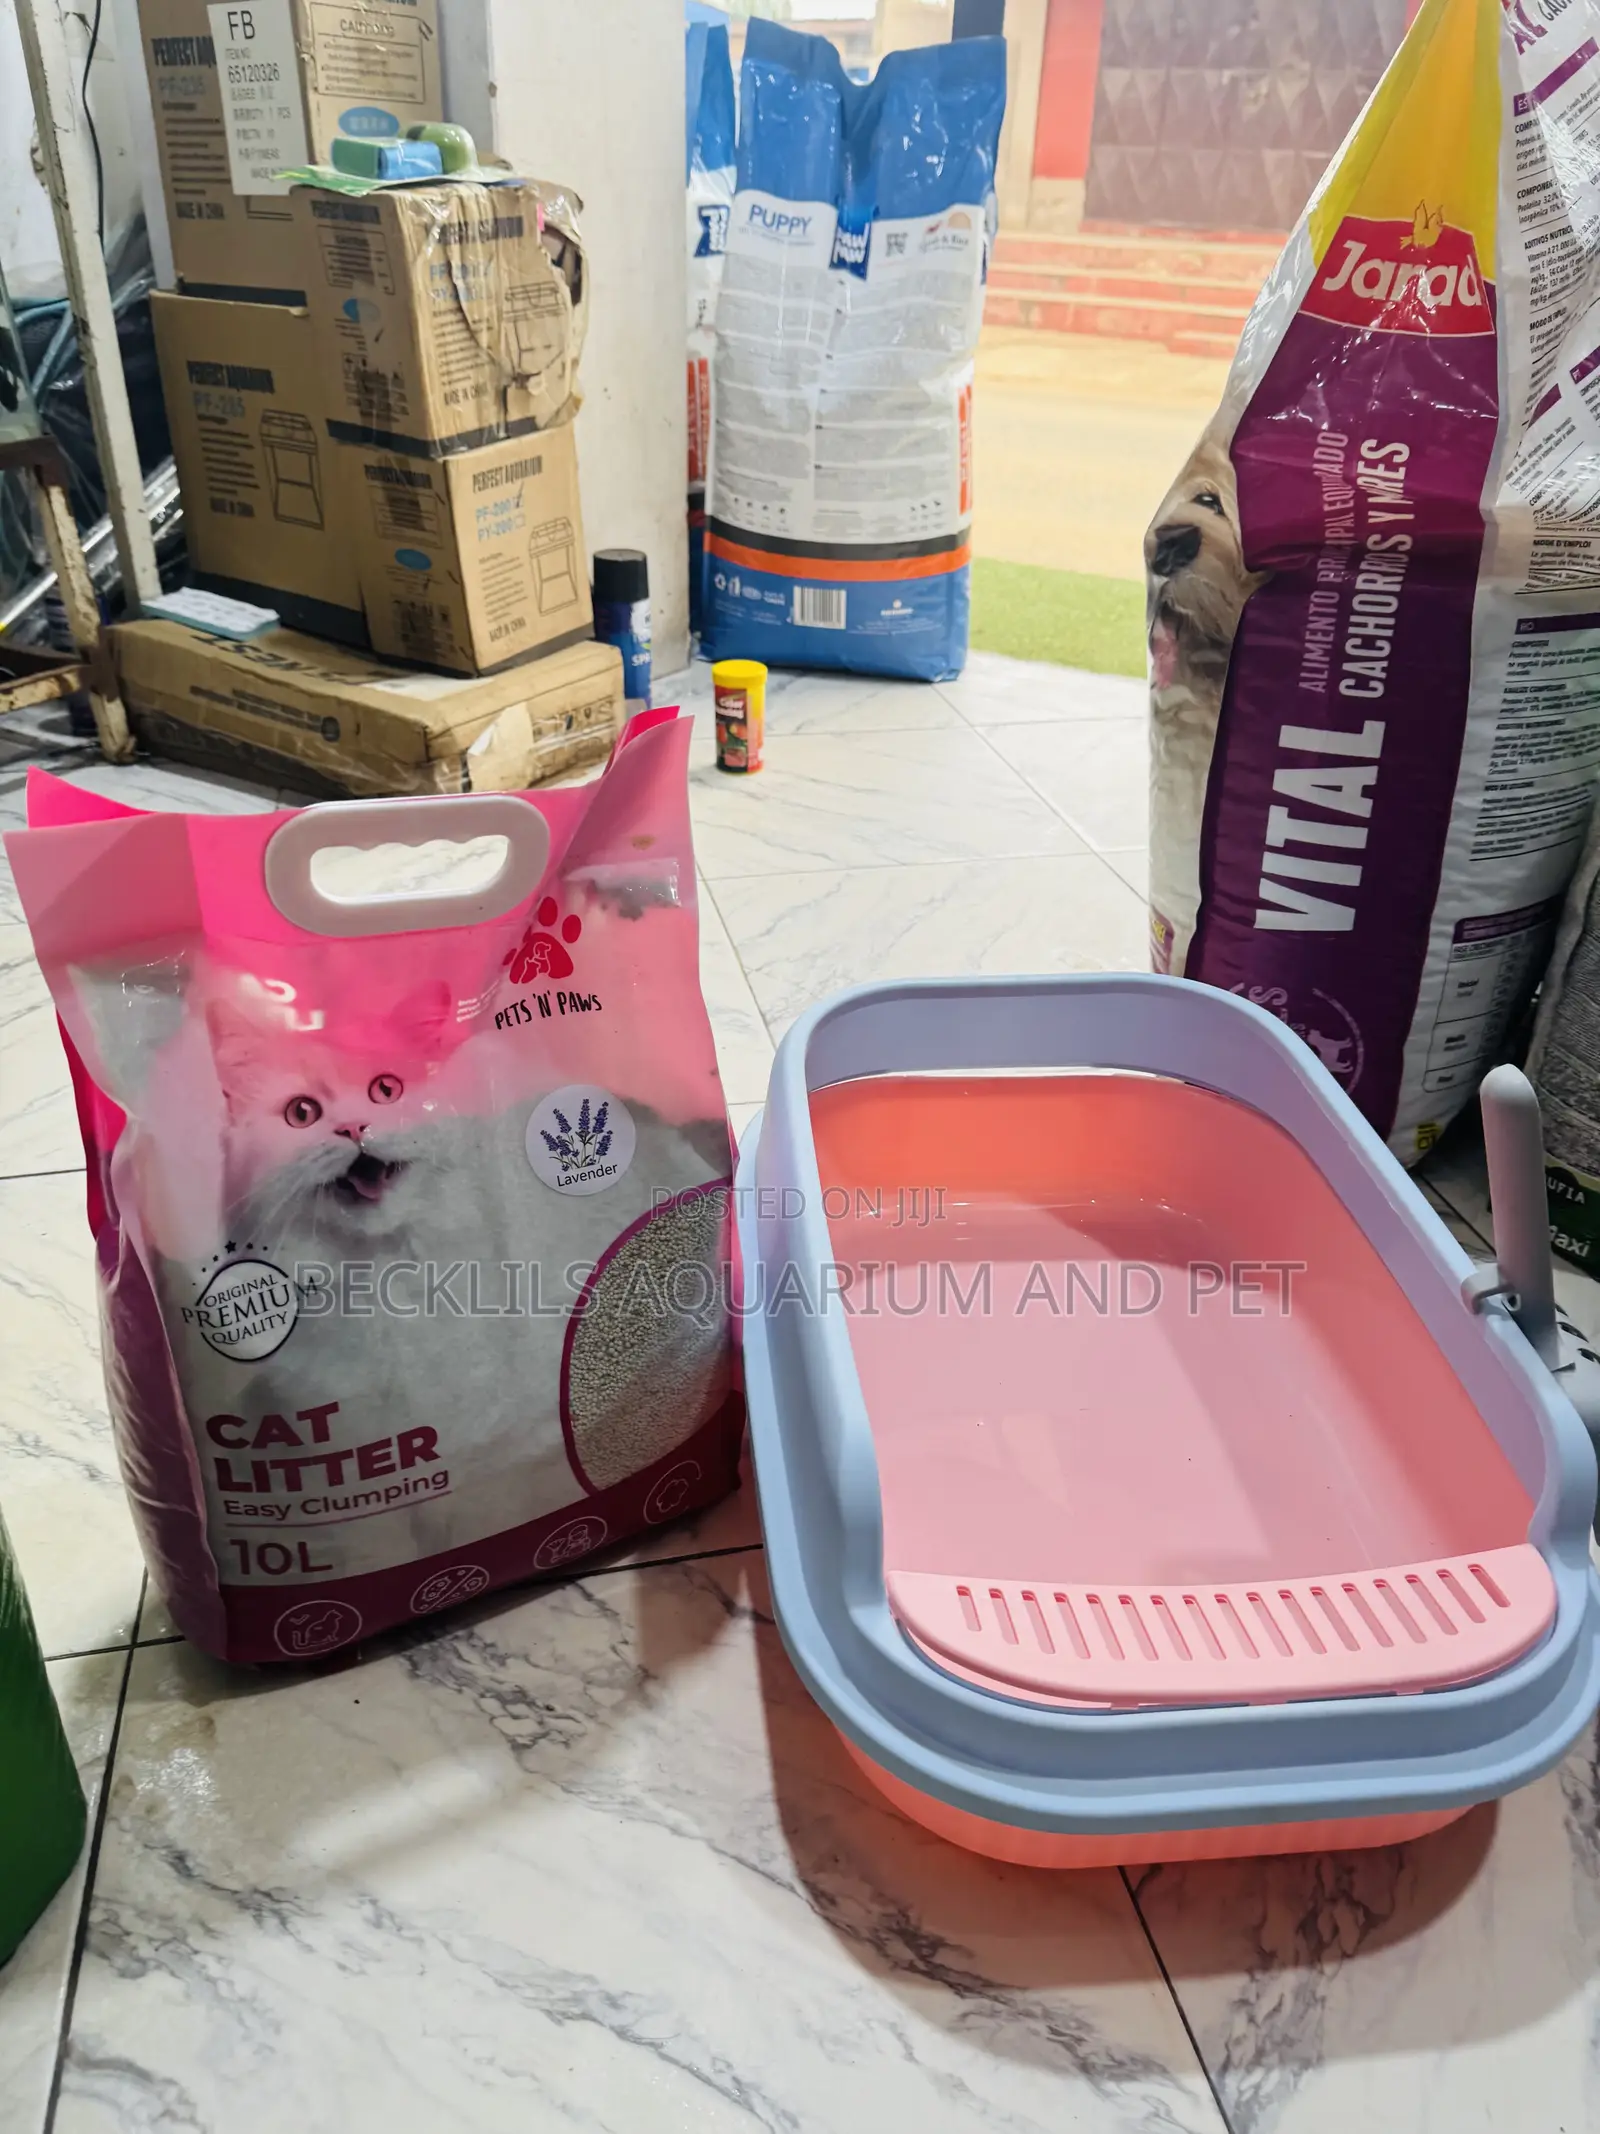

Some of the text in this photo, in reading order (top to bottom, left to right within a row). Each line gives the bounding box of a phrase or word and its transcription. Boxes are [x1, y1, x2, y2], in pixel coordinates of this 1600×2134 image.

[227, 10, 255, 40] FB
[228, 63, 280, 83] 65120326
[749, 204, 812, 236] PUPPY
[1322, 240, 1483, 309] Jarad
[472, 466, 504, 494] PERFECT
[1367, 510, 1416, 524] Y
[1298, 589, 1340, 694] ALIMENTO
[1253, 720, 1386, 931] VITAL
[494, 1001, 533, 1030] PETS
[556, 991, 602, 1015] PAWS
[557, 1164, 618, 1187] Lavender
[203, 1274, 278, 1308] ORIGINAL
[211, 1311, 288, 1345] QUALITY
[206, 1401, 339, 1450] CAT
[213, 1425, 441, 1494] LITTER
[224, 1470, 449, 1521] Easy Clumping
[230, 1539, 333, 1576] 10L
